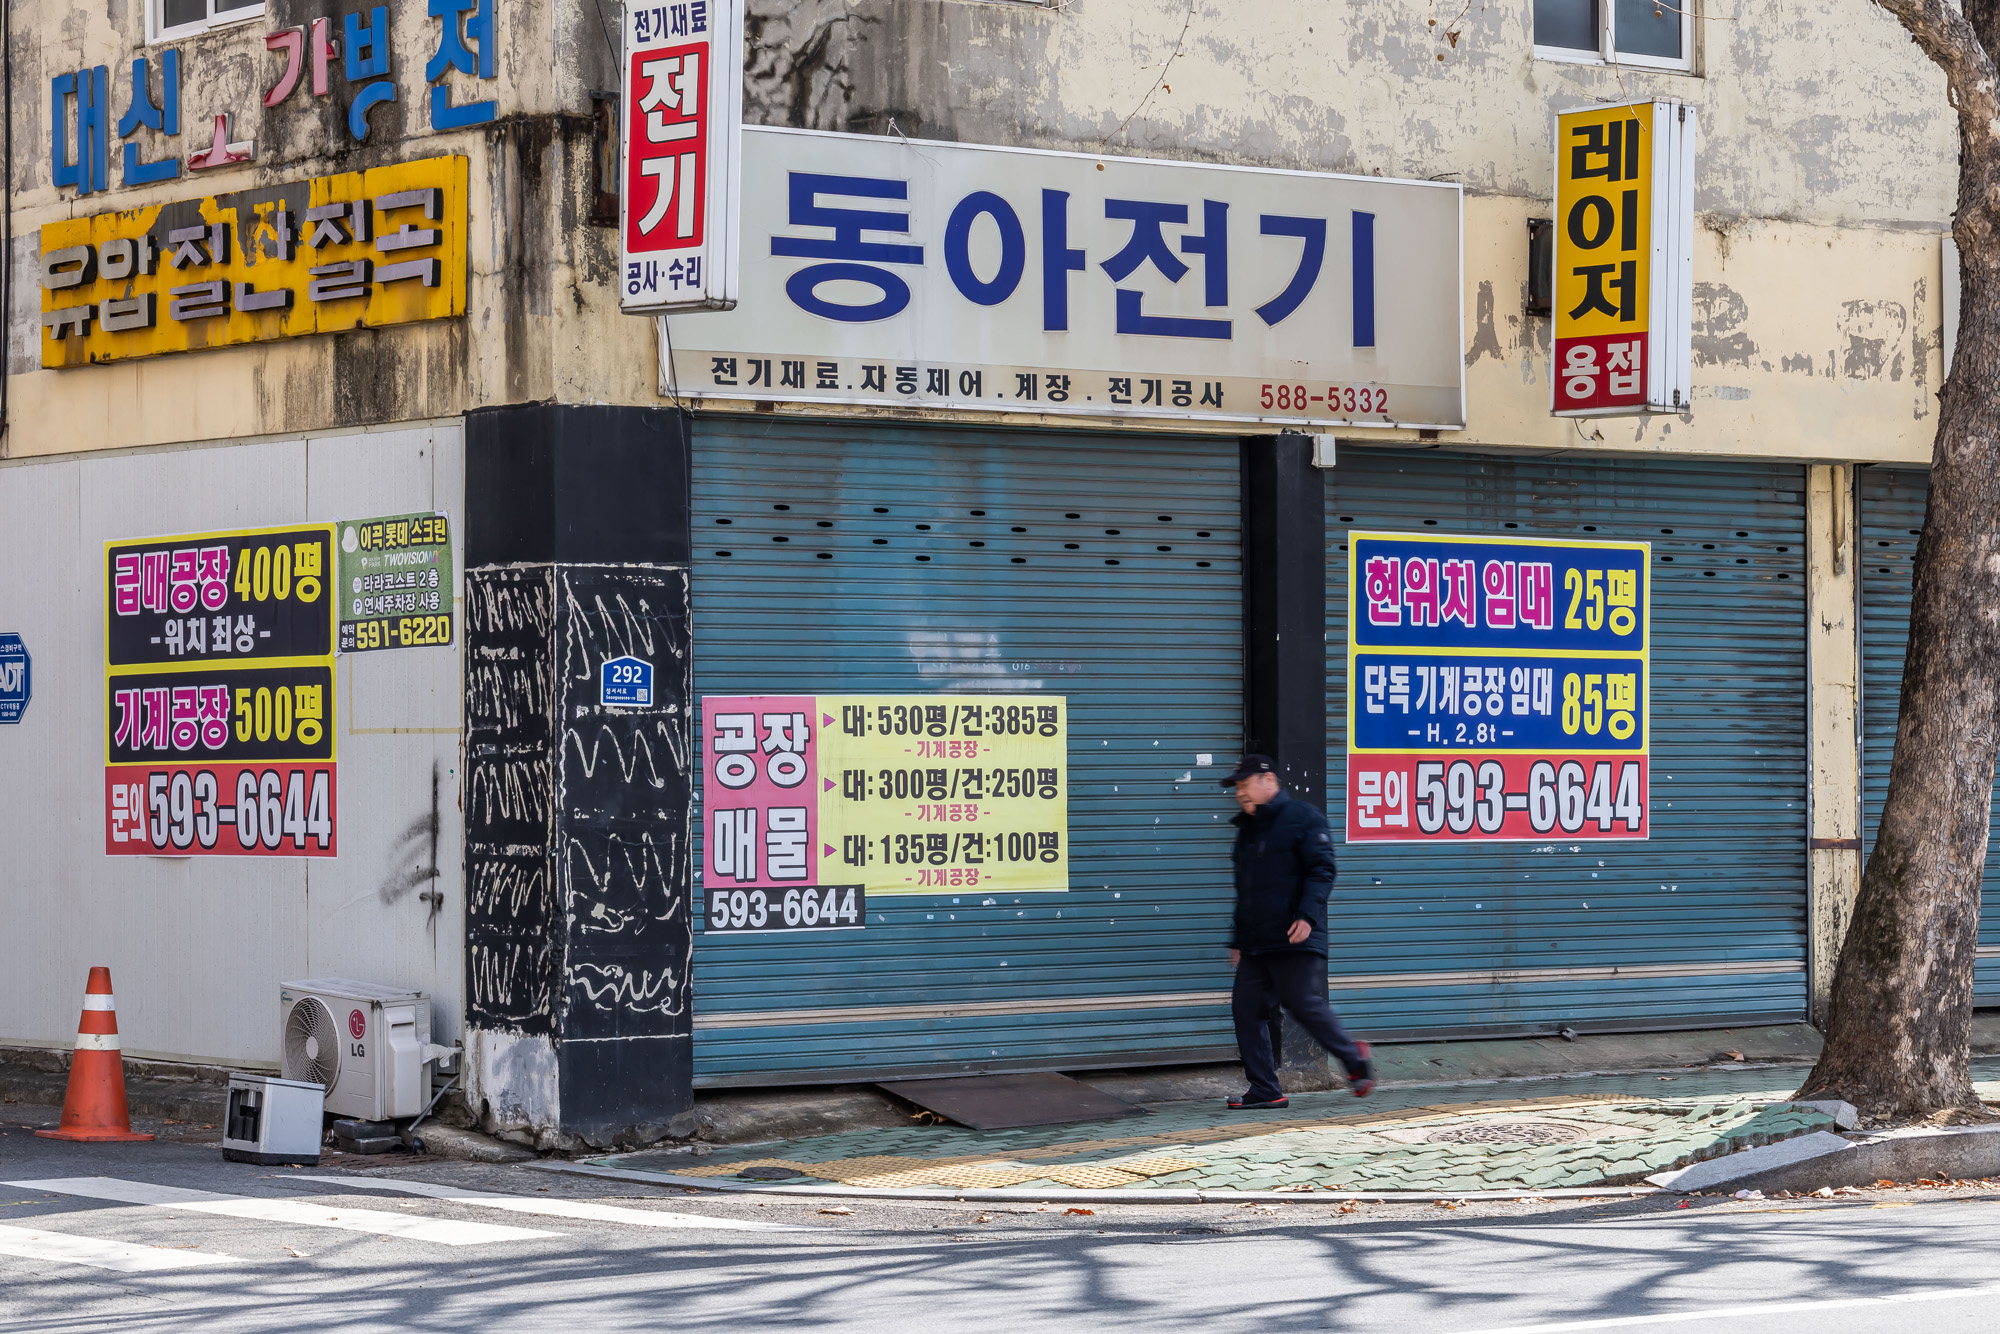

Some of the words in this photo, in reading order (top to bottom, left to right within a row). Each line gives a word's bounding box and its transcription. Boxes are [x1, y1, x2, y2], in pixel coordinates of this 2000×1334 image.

[634, 2, 708, 43] 전기재료
[51, 48, 182, 195] 대신
[637, 52, 700, 239] 전기
[1567, 119, 1641, 323] 레이저
[627, 256, 702, 295] 공사·수리
[770, 171, 1376, 348] 동아전기
[1108, 377, 1225, 408] 전기공사
[1260, 384, 1389, 413] 588-5332
[1562, 340, 1642, 399] 용접
[114, 546, 230, 616] 급매공장
[234, 541, 322, 603] 400평
[364, 571, 417, 593] 라라코스트
[364, 592, 417, 615] 연세주차장
[419, 591, 439, 611] 사용
[1365, 556, 1476, 627] 현위치
[1483, 559, 1553, 630] 임대
[1564, 567, 1637, 636] 25평
[356, 615, 450, 649] 591-6220
[612, 665, 642, 684] 292
[1364, 665, 1410, 714] 단독
[1415, 666, 1506, 716] 기계공장
[1510, 667, 1553, 715] 임대
[1562, 672, 1636, 740] 85평
[115, 685, 230, 750] 기계공장
[235, 684, 323, 745] 500평
[713, 711, 811, 789] 공장
[112, 783, 147, 842] 문의
[148, 769, 332, 850] 593-6644
[1357, 771, 1409, 828] 문의
[1415, 759, 1642, 834] 593-6644
[713, 806, 809, 883] 매물
[711, 888, 858, 929] 593-6644
[351, 1043, 365, 1057] LG
